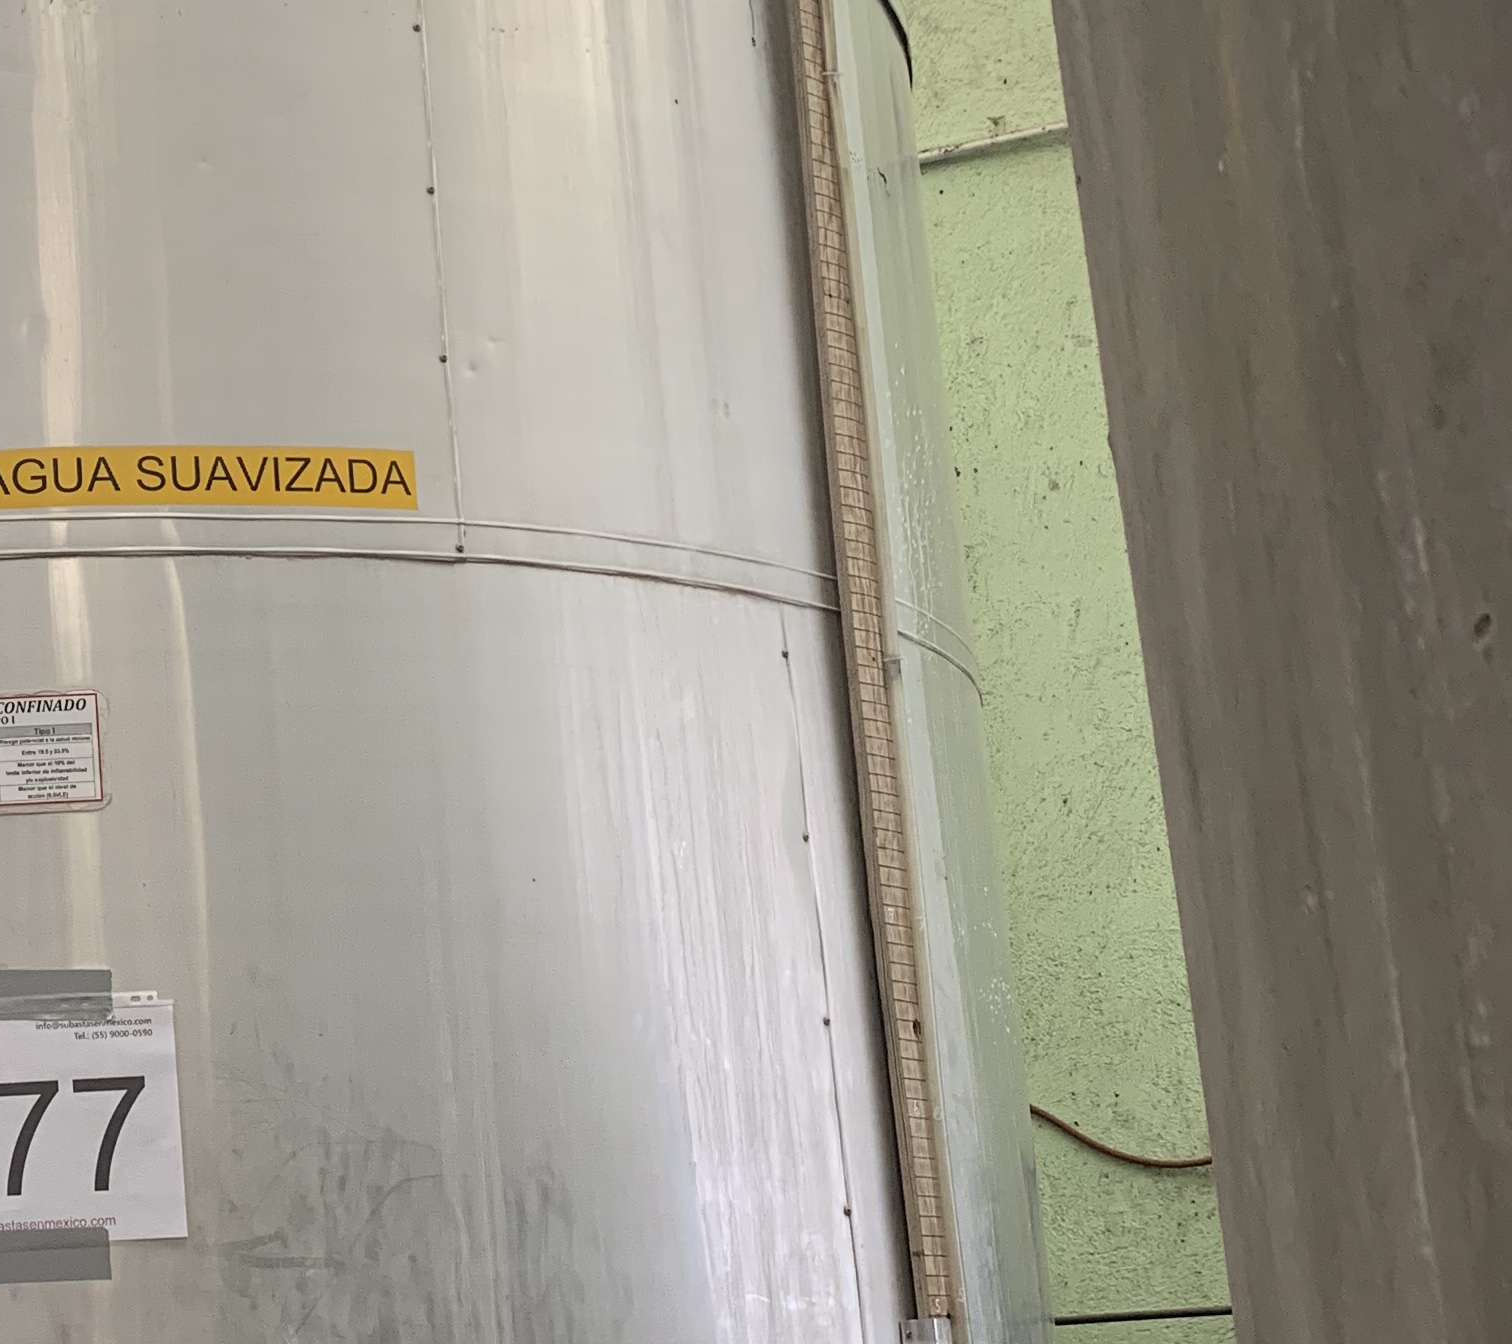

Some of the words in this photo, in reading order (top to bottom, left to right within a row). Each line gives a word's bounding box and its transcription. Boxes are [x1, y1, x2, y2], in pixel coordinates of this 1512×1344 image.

[136, 456, 412, 496] SUAVIZADA
[34, 727, 51, 736] Tipo
[91, 1031, 107, 1040] (55)
[109, 1029, 153, 1038] 9000-0590
